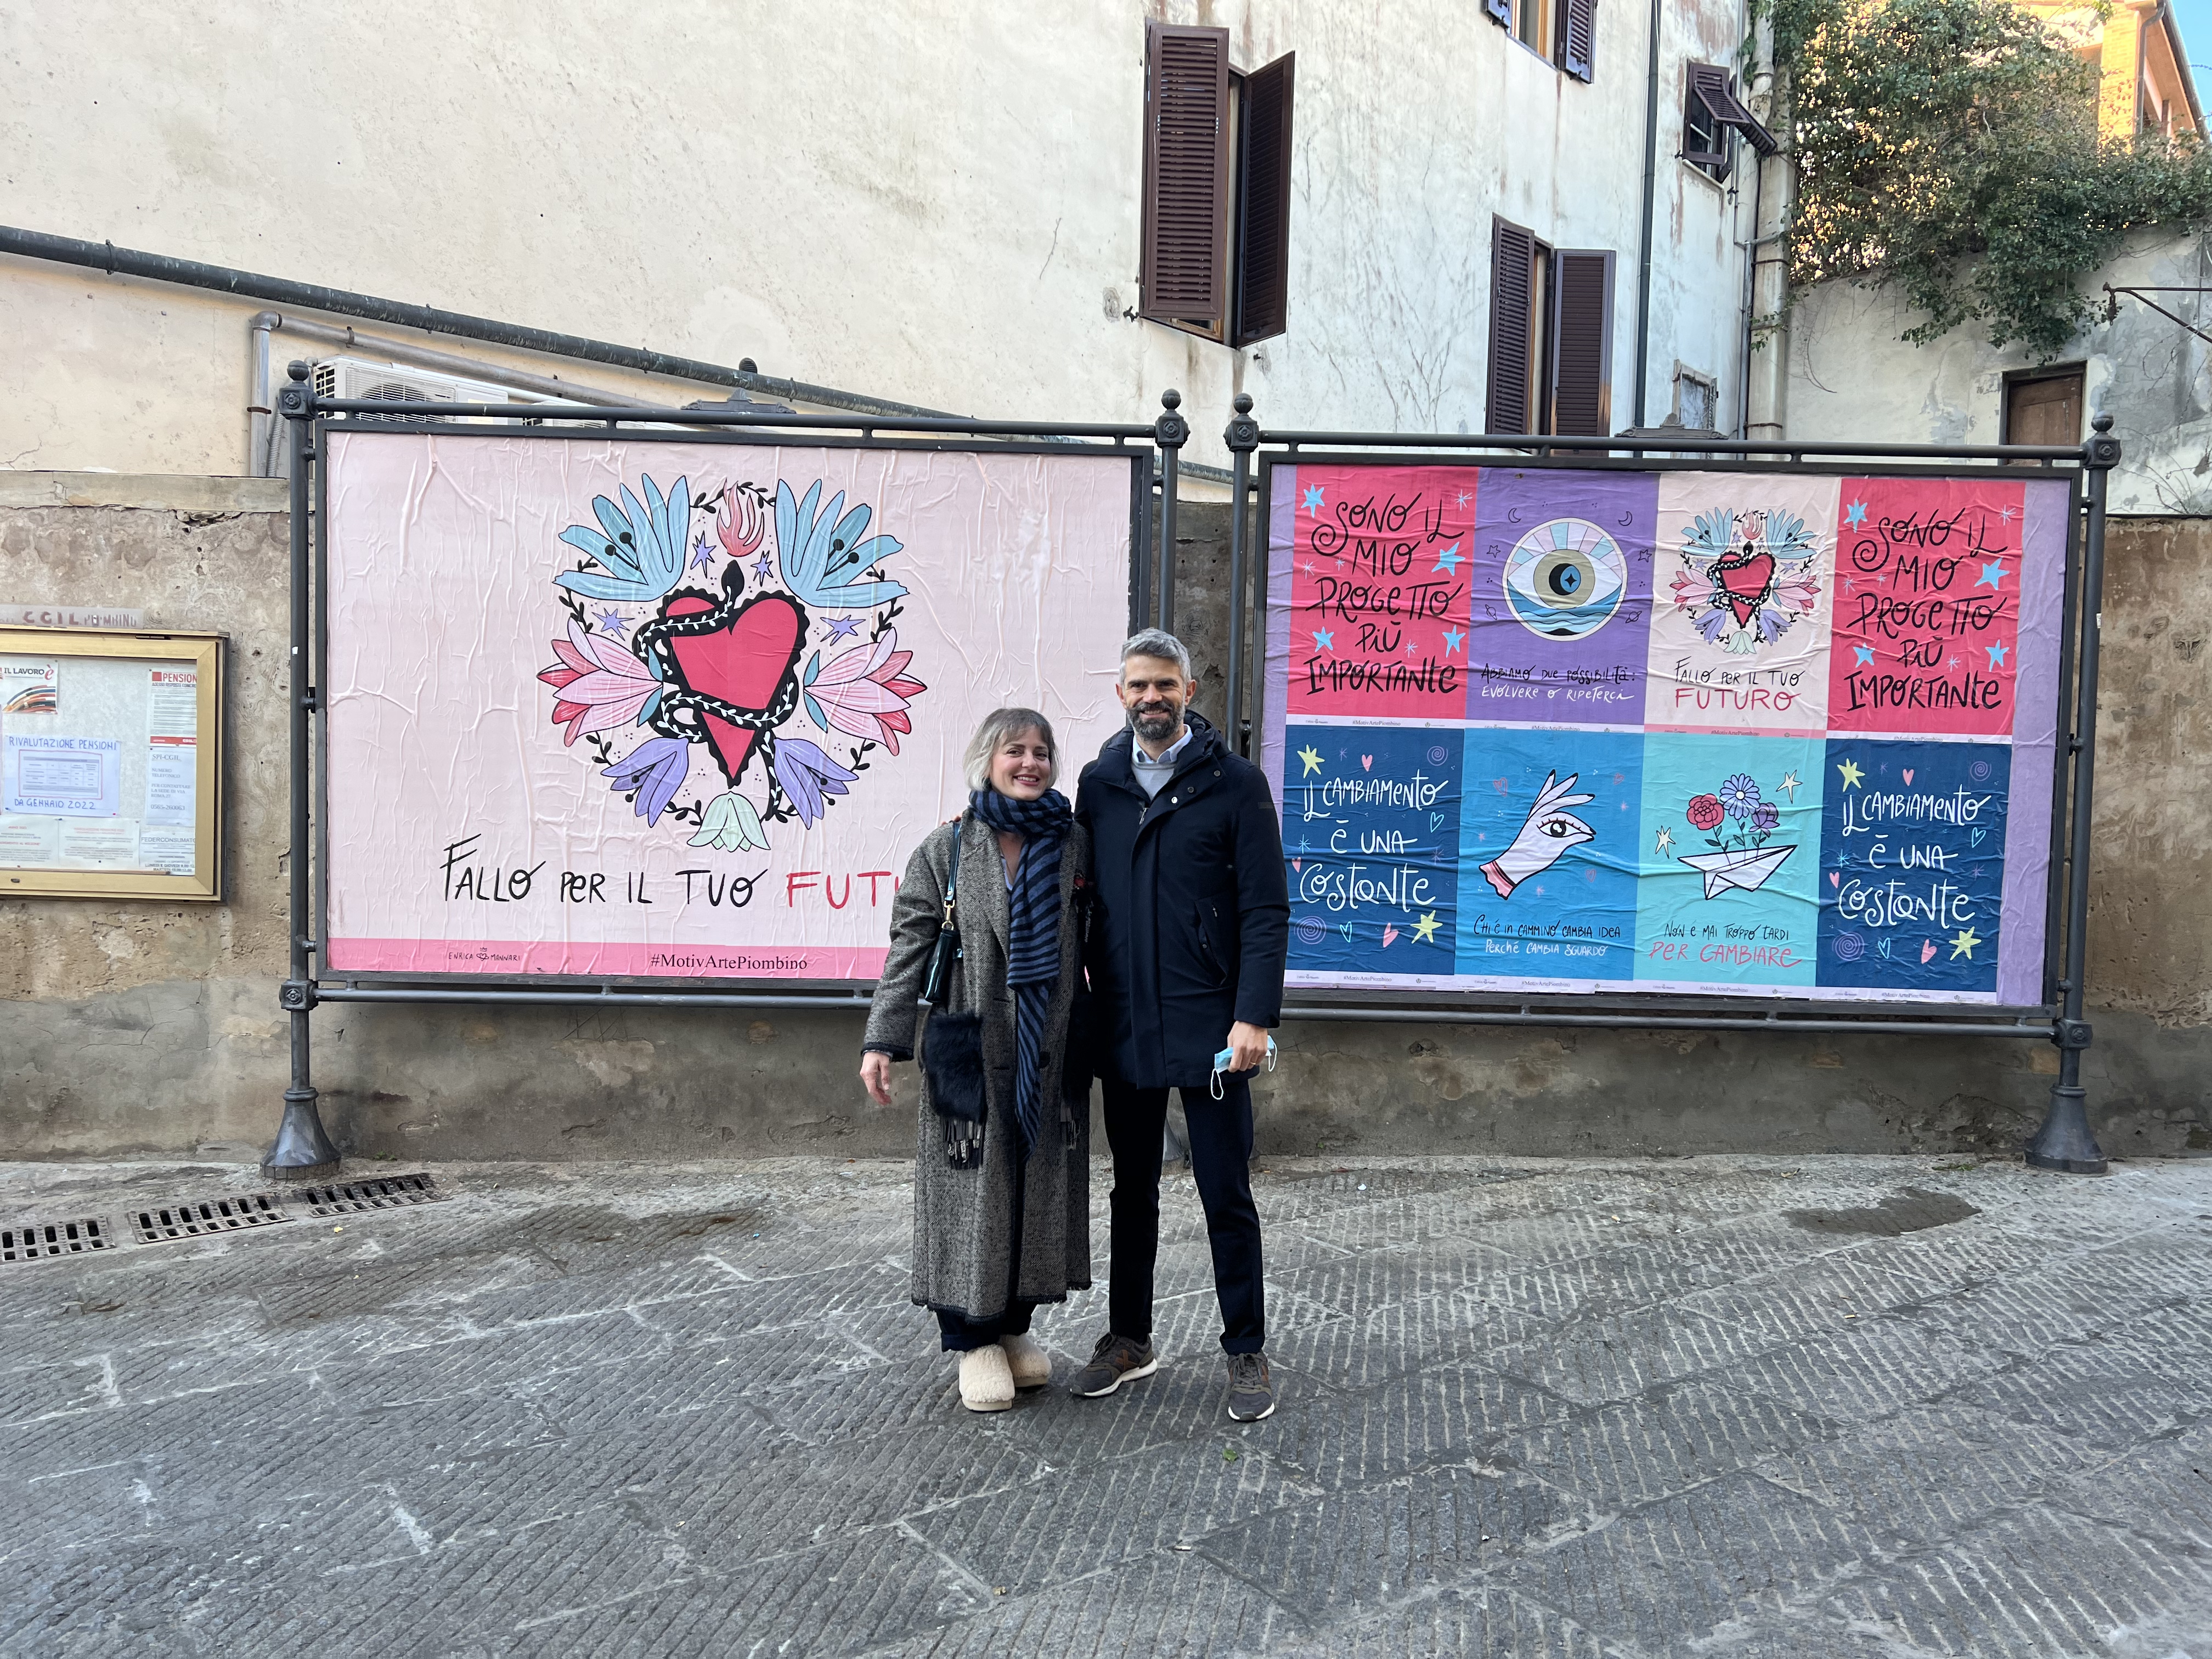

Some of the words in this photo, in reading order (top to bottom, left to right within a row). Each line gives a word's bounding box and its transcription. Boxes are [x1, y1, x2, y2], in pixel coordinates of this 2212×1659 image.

[1311, 493, 1422, 556] SONO
[1425, 498, 1465, 543] IL
[1852, 507, 1966, 572] SONO
[1968, 514, 2008, 557] IL
[1352, 539, 1420, 577] MIO
[1893, 555, 1963, 592] MIO
[44, 664, 54, 680] è
[1674, 656, 1717, 684] FALLO
[1749, 672, 1759, 685] IL
[1768, 670, 1805, 686] TUO
[1675, 688, 1802, 711] FUTURO
[9, 736, 75, 748] RIVALUTAZIONE
[79, 740, 117, 751] PENSIONI
[26, 798, 64, 808] GENNAIO
[68, 800, 96, 809] 2022
[1304, 780, 1331, 822] IL
[1843, 794, 1870, 837] IL
[1361, 830, 1418, 854] UNA
[1900, 845, 1959, 870] UNA
[439, 833, 546, 901] FALLO
[628, 871, 653, 904] IL
[675, 868, 768, 907] TUO
[786, 871, 900, 910] FUT
[1517, 919, 1561, 937] CAMMINO
[1562, 926, 1593, 939] CAMBIA
[1702, 924, 1717, 940] MAI
[1724, 923, 1762, 940] TROPPO
[448, 952, 473, 960] ENRICA
[1526, 942, 1560, 955] CAMBIA
[1565, 944, 1609, 956] SGUARDO
[651, 953, 808, 970] #MotivArtePiombino
